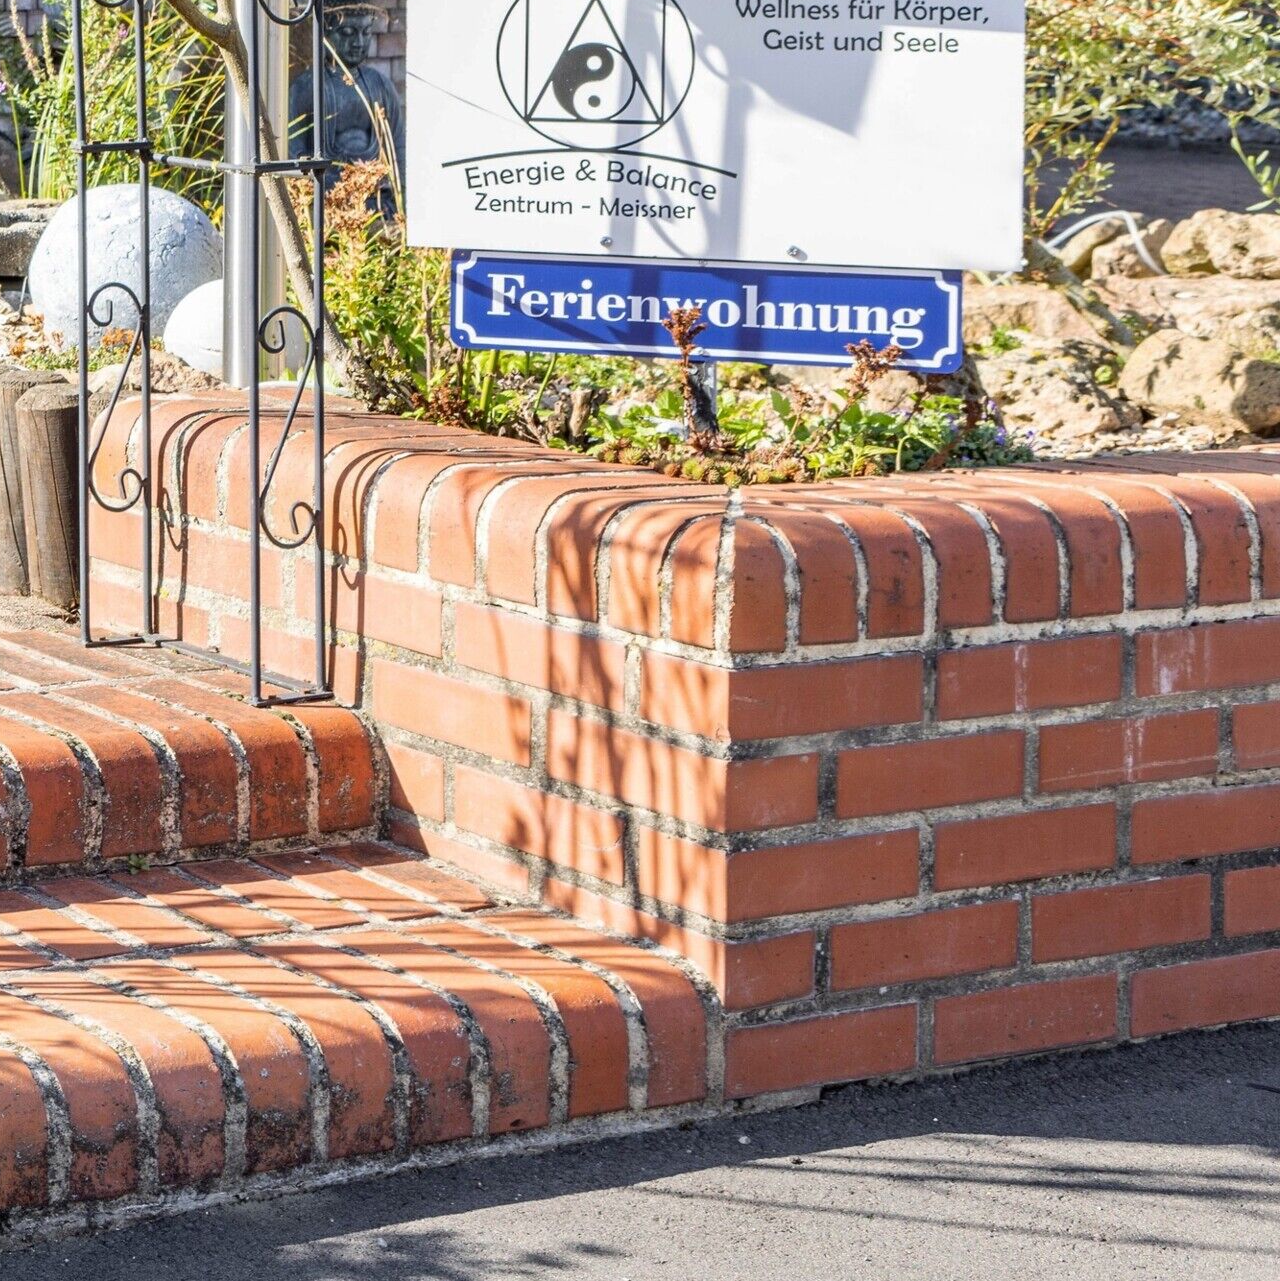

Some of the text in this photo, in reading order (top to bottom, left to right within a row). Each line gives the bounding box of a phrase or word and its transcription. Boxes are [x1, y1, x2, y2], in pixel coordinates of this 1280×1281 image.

[893, 0, 989, 25] Körper,
[763, 29, 959, 53] Geist und Seele
[465, 159, 717, 200] Energie & Balance
[474, 192, 573, 215] Zentrum
[599, 197, 696, 219] Meissner
[487, 273, 926, 349] Ferienwohnung
